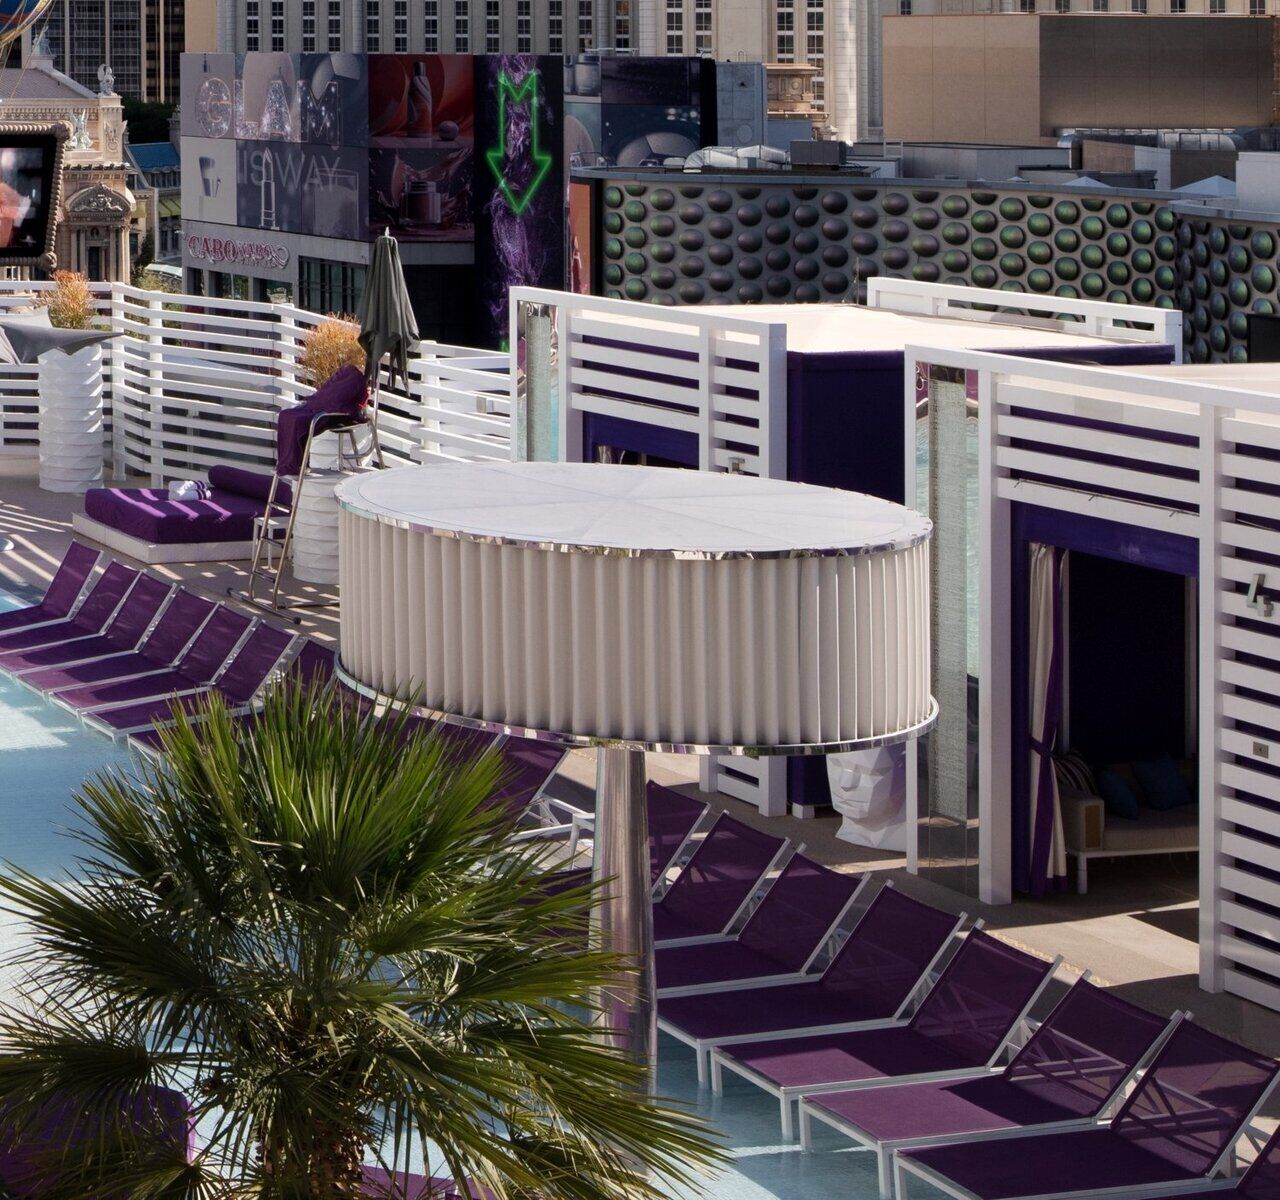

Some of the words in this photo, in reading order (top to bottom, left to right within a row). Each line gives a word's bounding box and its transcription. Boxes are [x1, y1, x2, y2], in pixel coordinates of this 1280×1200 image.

[198, 77, 339, 145] GLAM
[275, 152, 341, 192] WAY
[188, 235, 238, 263] CABO
